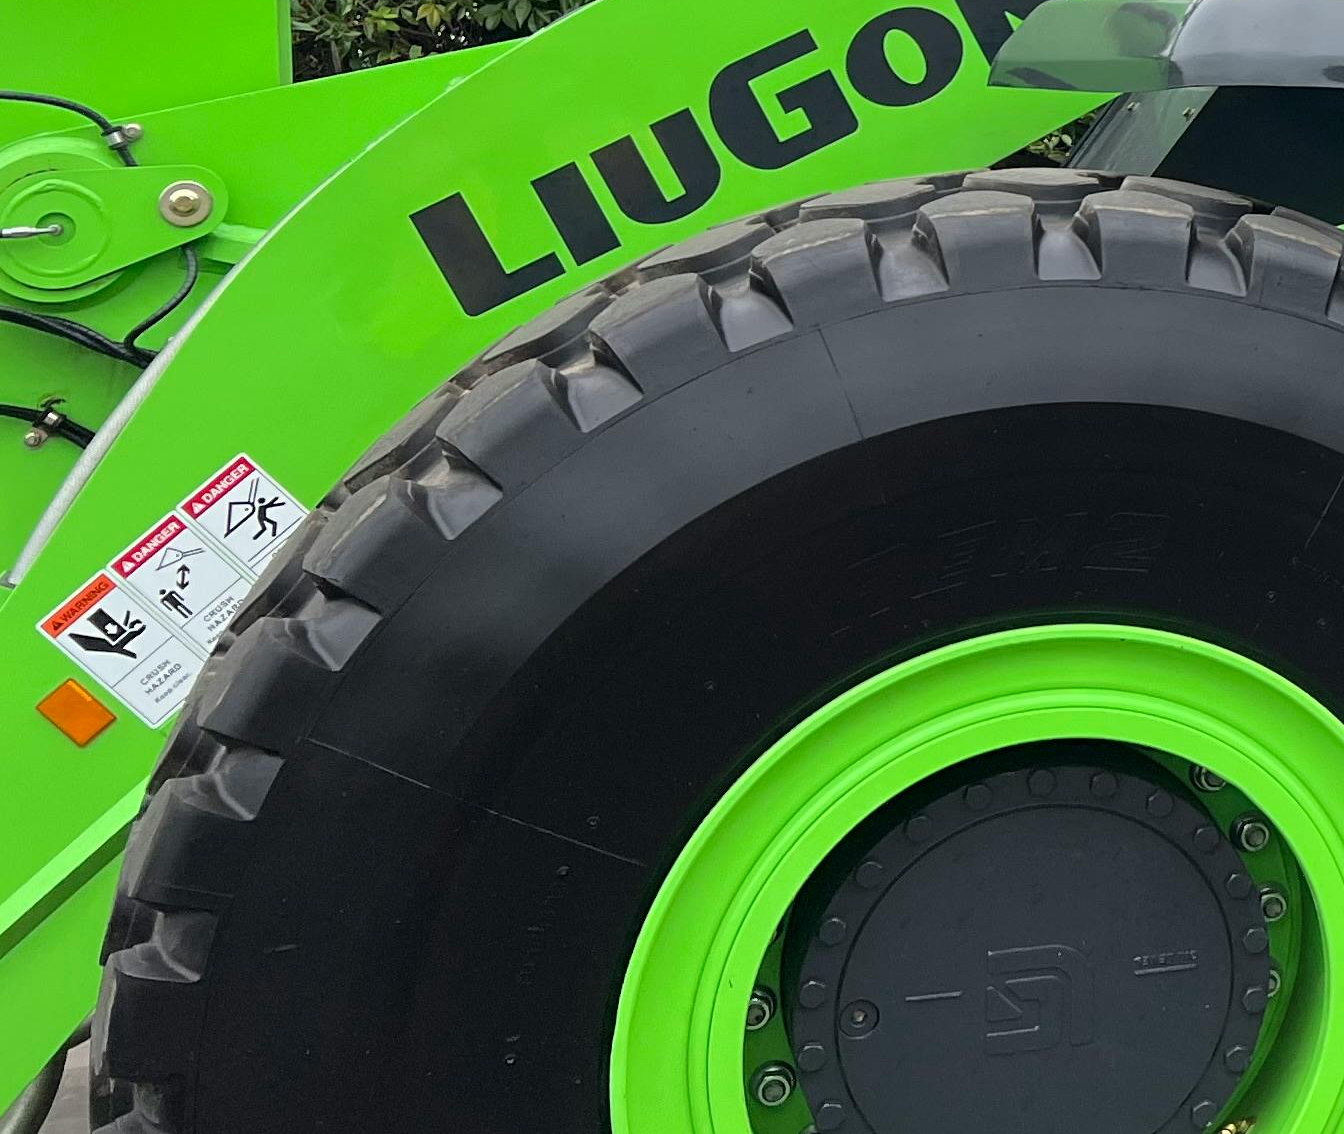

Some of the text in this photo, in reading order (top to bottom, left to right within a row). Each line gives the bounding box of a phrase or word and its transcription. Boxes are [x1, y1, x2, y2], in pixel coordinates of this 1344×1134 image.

[201, 463, 249, 505] DANGER
[131, 521, 181, 561] DANGER
[61, 580, 110, 623] WARNING
[203, 595, 235, 622] CRUSH
[139, 659, 172, 686] CRUSH
[144, 663, 182, 695] HAZARD
